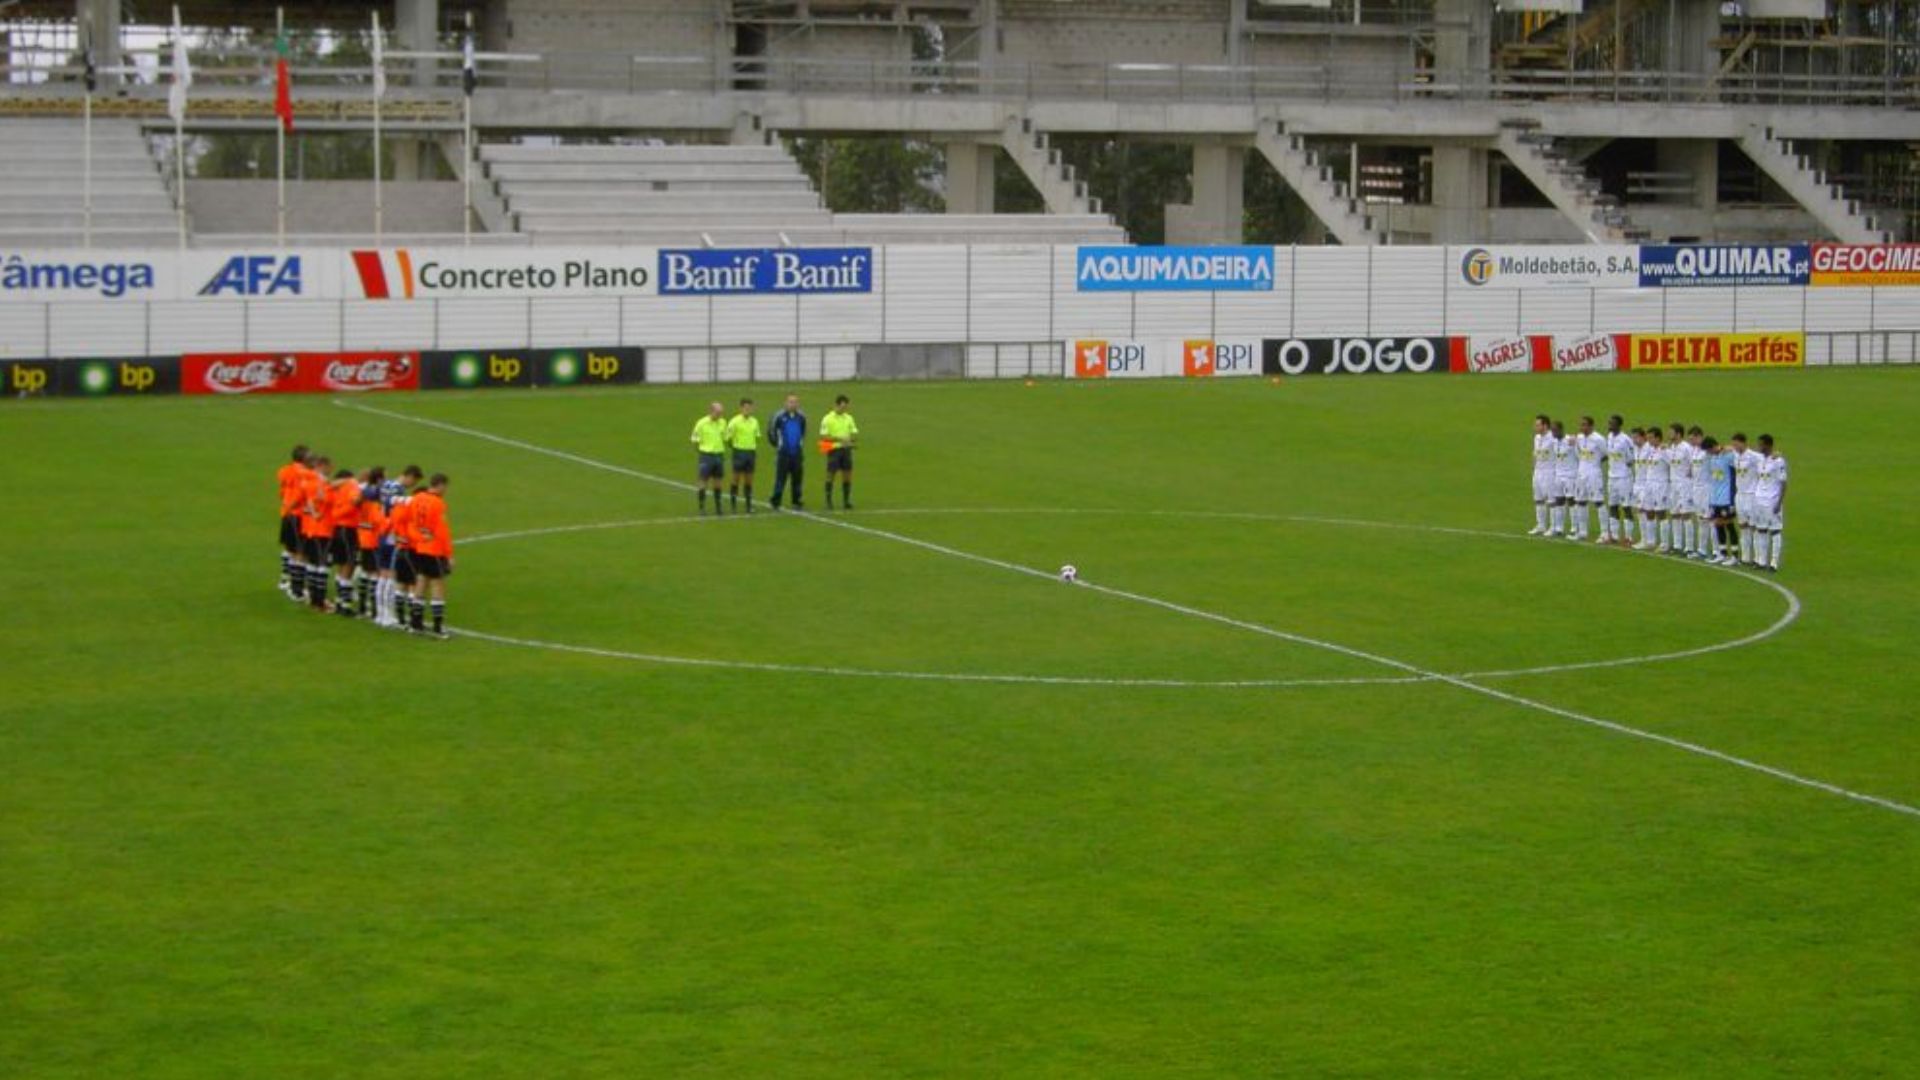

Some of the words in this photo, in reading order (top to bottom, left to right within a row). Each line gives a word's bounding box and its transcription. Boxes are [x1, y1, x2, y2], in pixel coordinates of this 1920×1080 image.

[0, 255, 154, 298] âmega
[198, 255, 302, 296] AFA
[420, 261, 557, 289] Concreto
[564, 260, 648, 289] Plano
[665, 253, 759, 290] Banif
[773, 252, 866, 289] Banif
[1080, 255, 1272, 281] AQUIMADEIRA
[1500, 256, 1602, 277] Moldebetão,
[1607, 256, 1639, 274] S.A.
[1107, 345, 1145, 371] BPI
[1215, 344, 1253, 370] BPI
[1279, 340, 1310, 375] O
[1324, 338, 1436, 374] JOGO
[1474, 340, 1526, 372] SAGRES
[1557, 337, 1609, 369] SAGRES
[1638, 337, 1722, 365] DELTA
[1729, 335, 1799, 364] cafés
[13, 365, 46, 390] bp
[120, 362, 155, 388] bp
[490, 353, 520, 381] bp
[588, 351, 619, 379] bp
